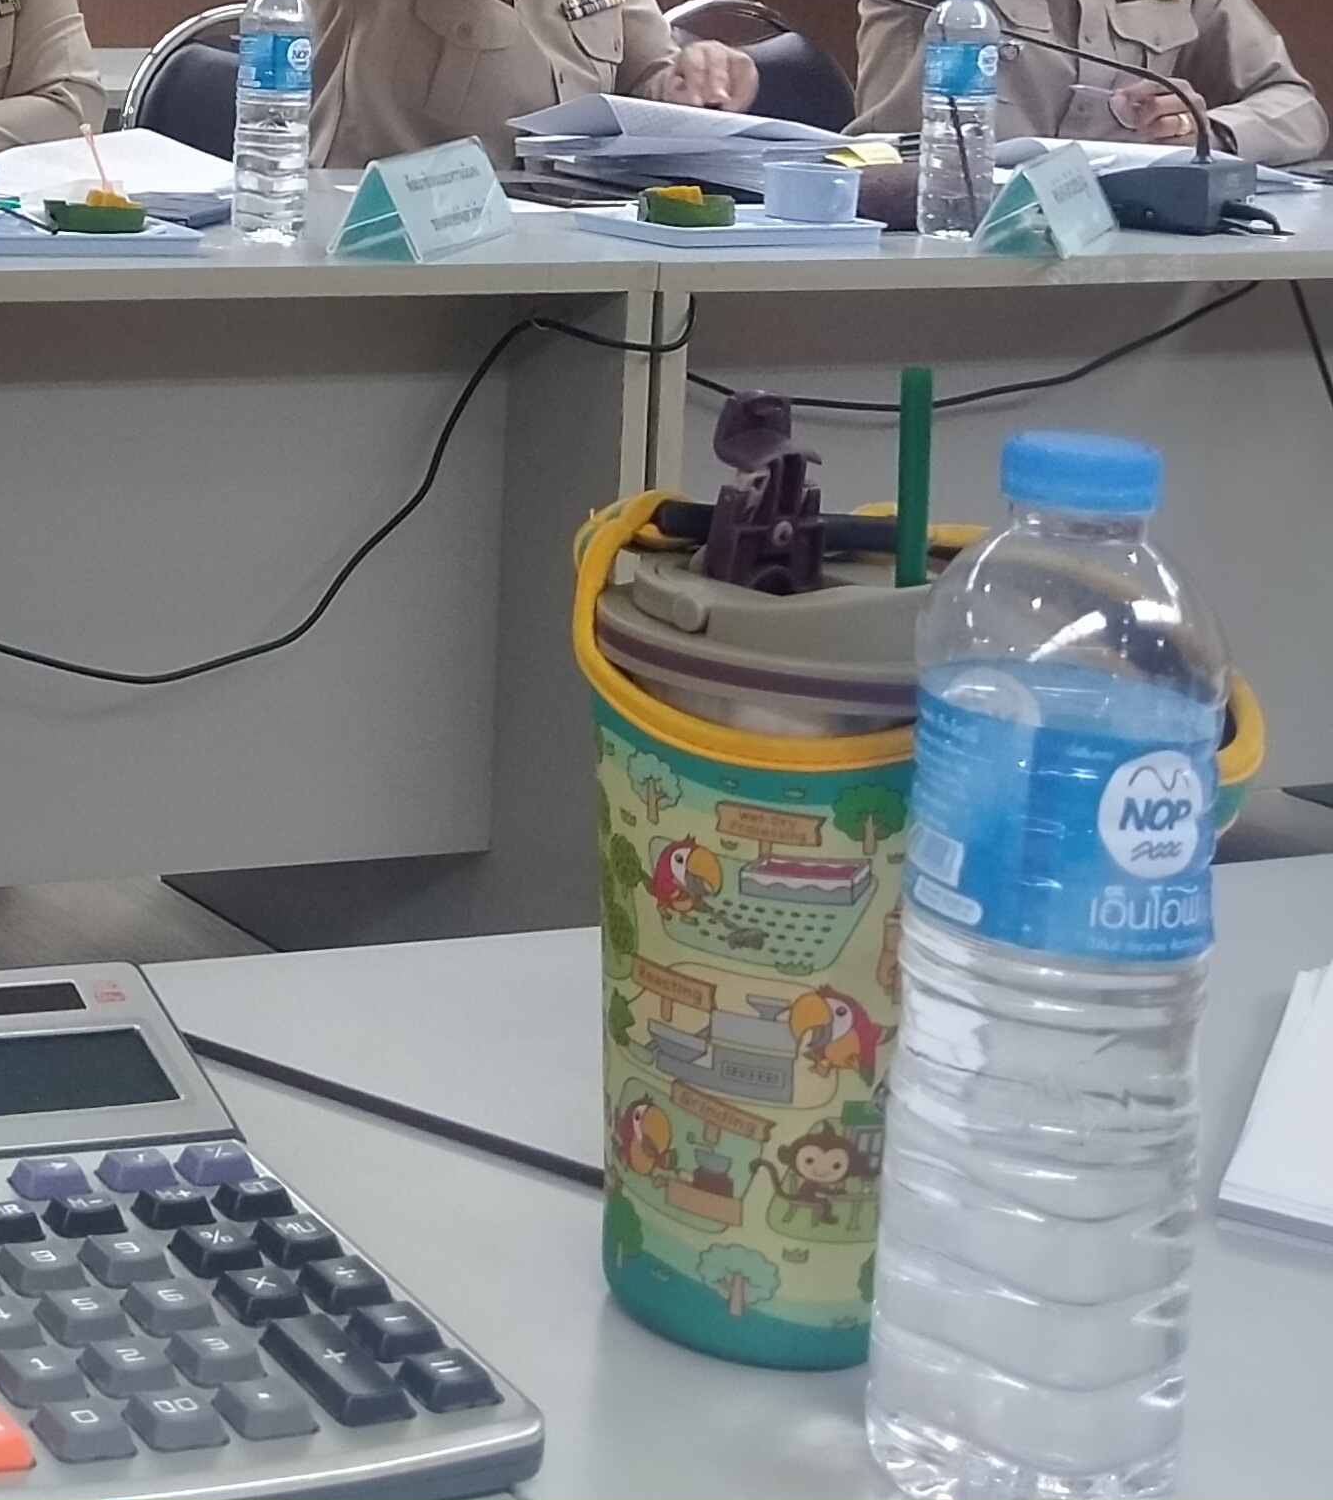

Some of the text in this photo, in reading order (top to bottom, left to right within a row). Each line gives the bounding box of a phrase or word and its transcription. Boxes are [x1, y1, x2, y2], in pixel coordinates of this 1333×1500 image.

[1119, 797, 1192, 831] NOP
[275, 1220, 317, 1235] MU
[113, 1241, 141, 1254] 9
[31, 1250, 57, 1263] 8
[157, 1288, 185, 1302] 6
[71, 1297, 99, 1311] 5
[202, 1337, 230, 1350] 3
[116, 1348, 146, 1363] 2
[30, 1357, 53, 1371] 1
